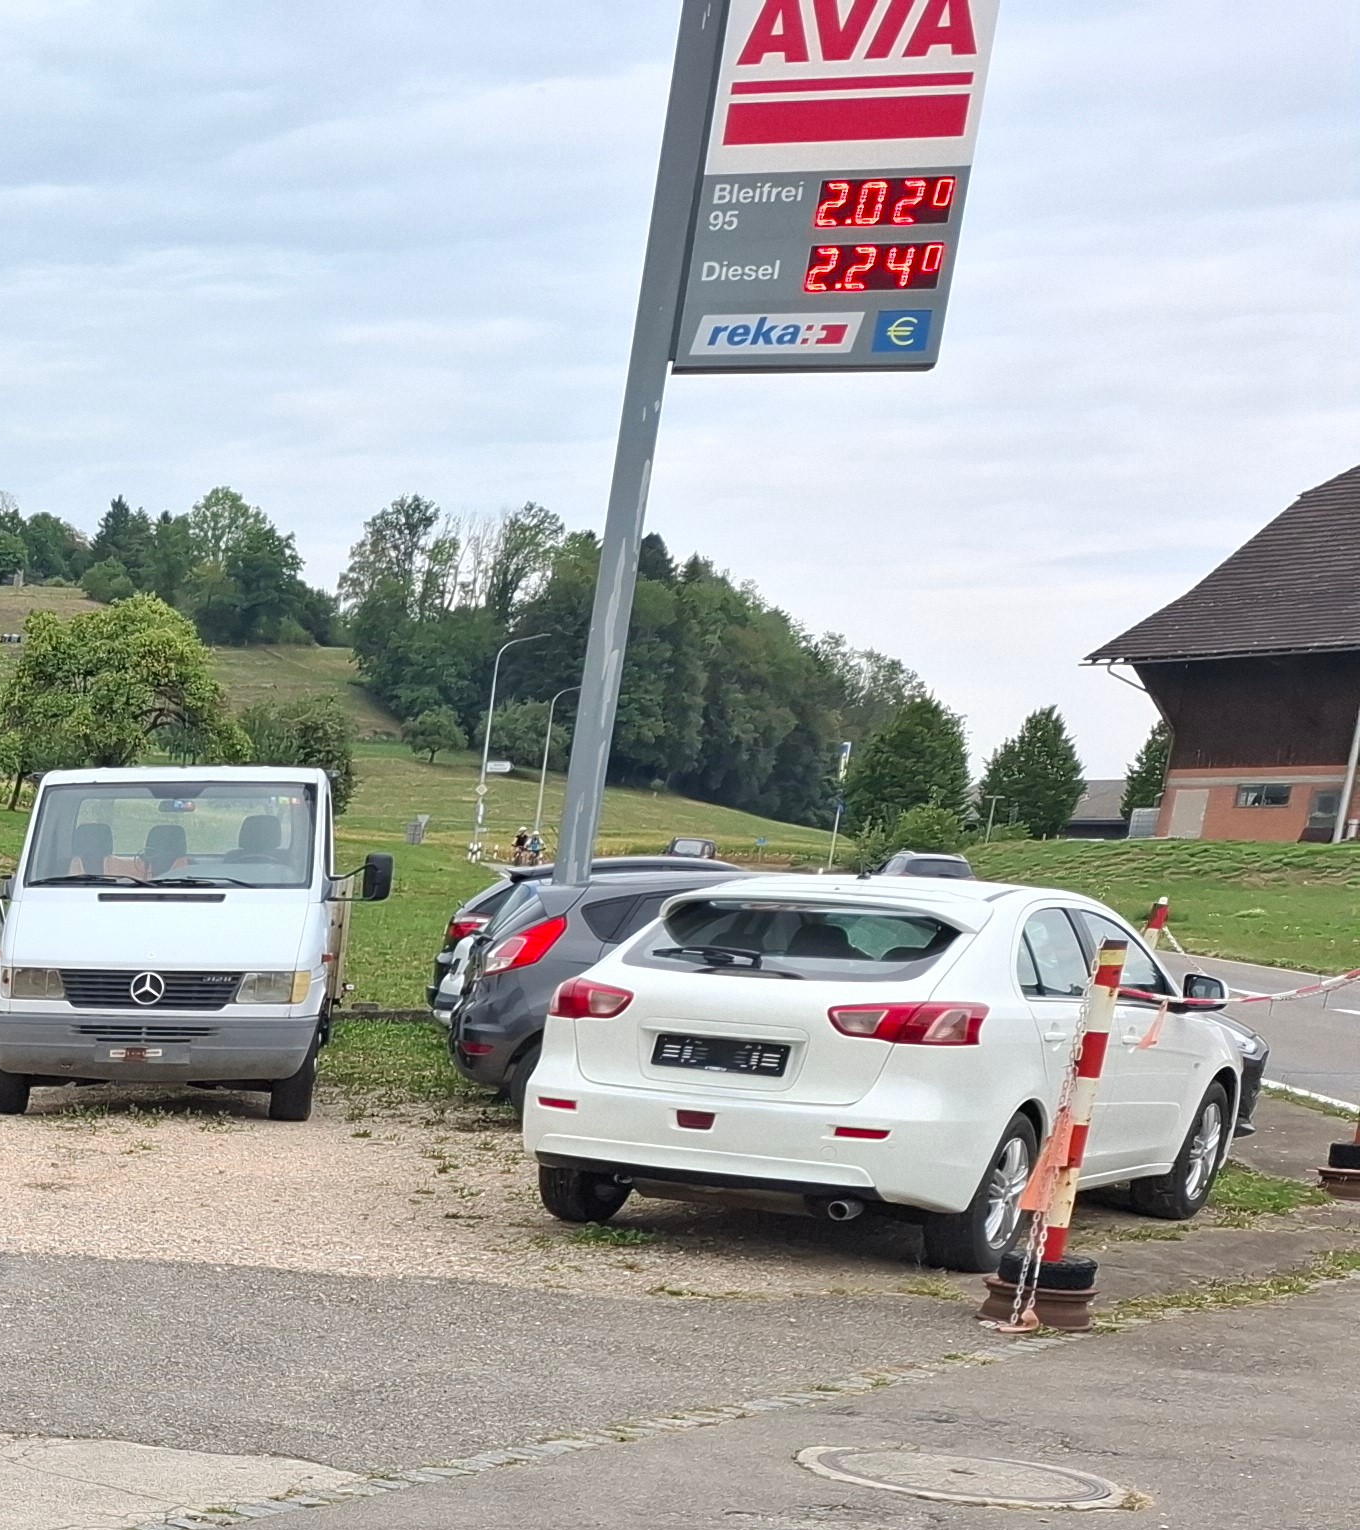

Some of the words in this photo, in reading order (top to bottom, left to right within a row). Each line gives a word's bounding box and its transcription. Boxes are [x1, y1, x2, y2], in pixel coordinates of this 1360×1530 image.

[737, 0, 977, 65] AVIA
[712, 182, 805, 205] Bleifrei
[708, 210, 740, 231] 95
[701, 260, 781, 282] Diesel
